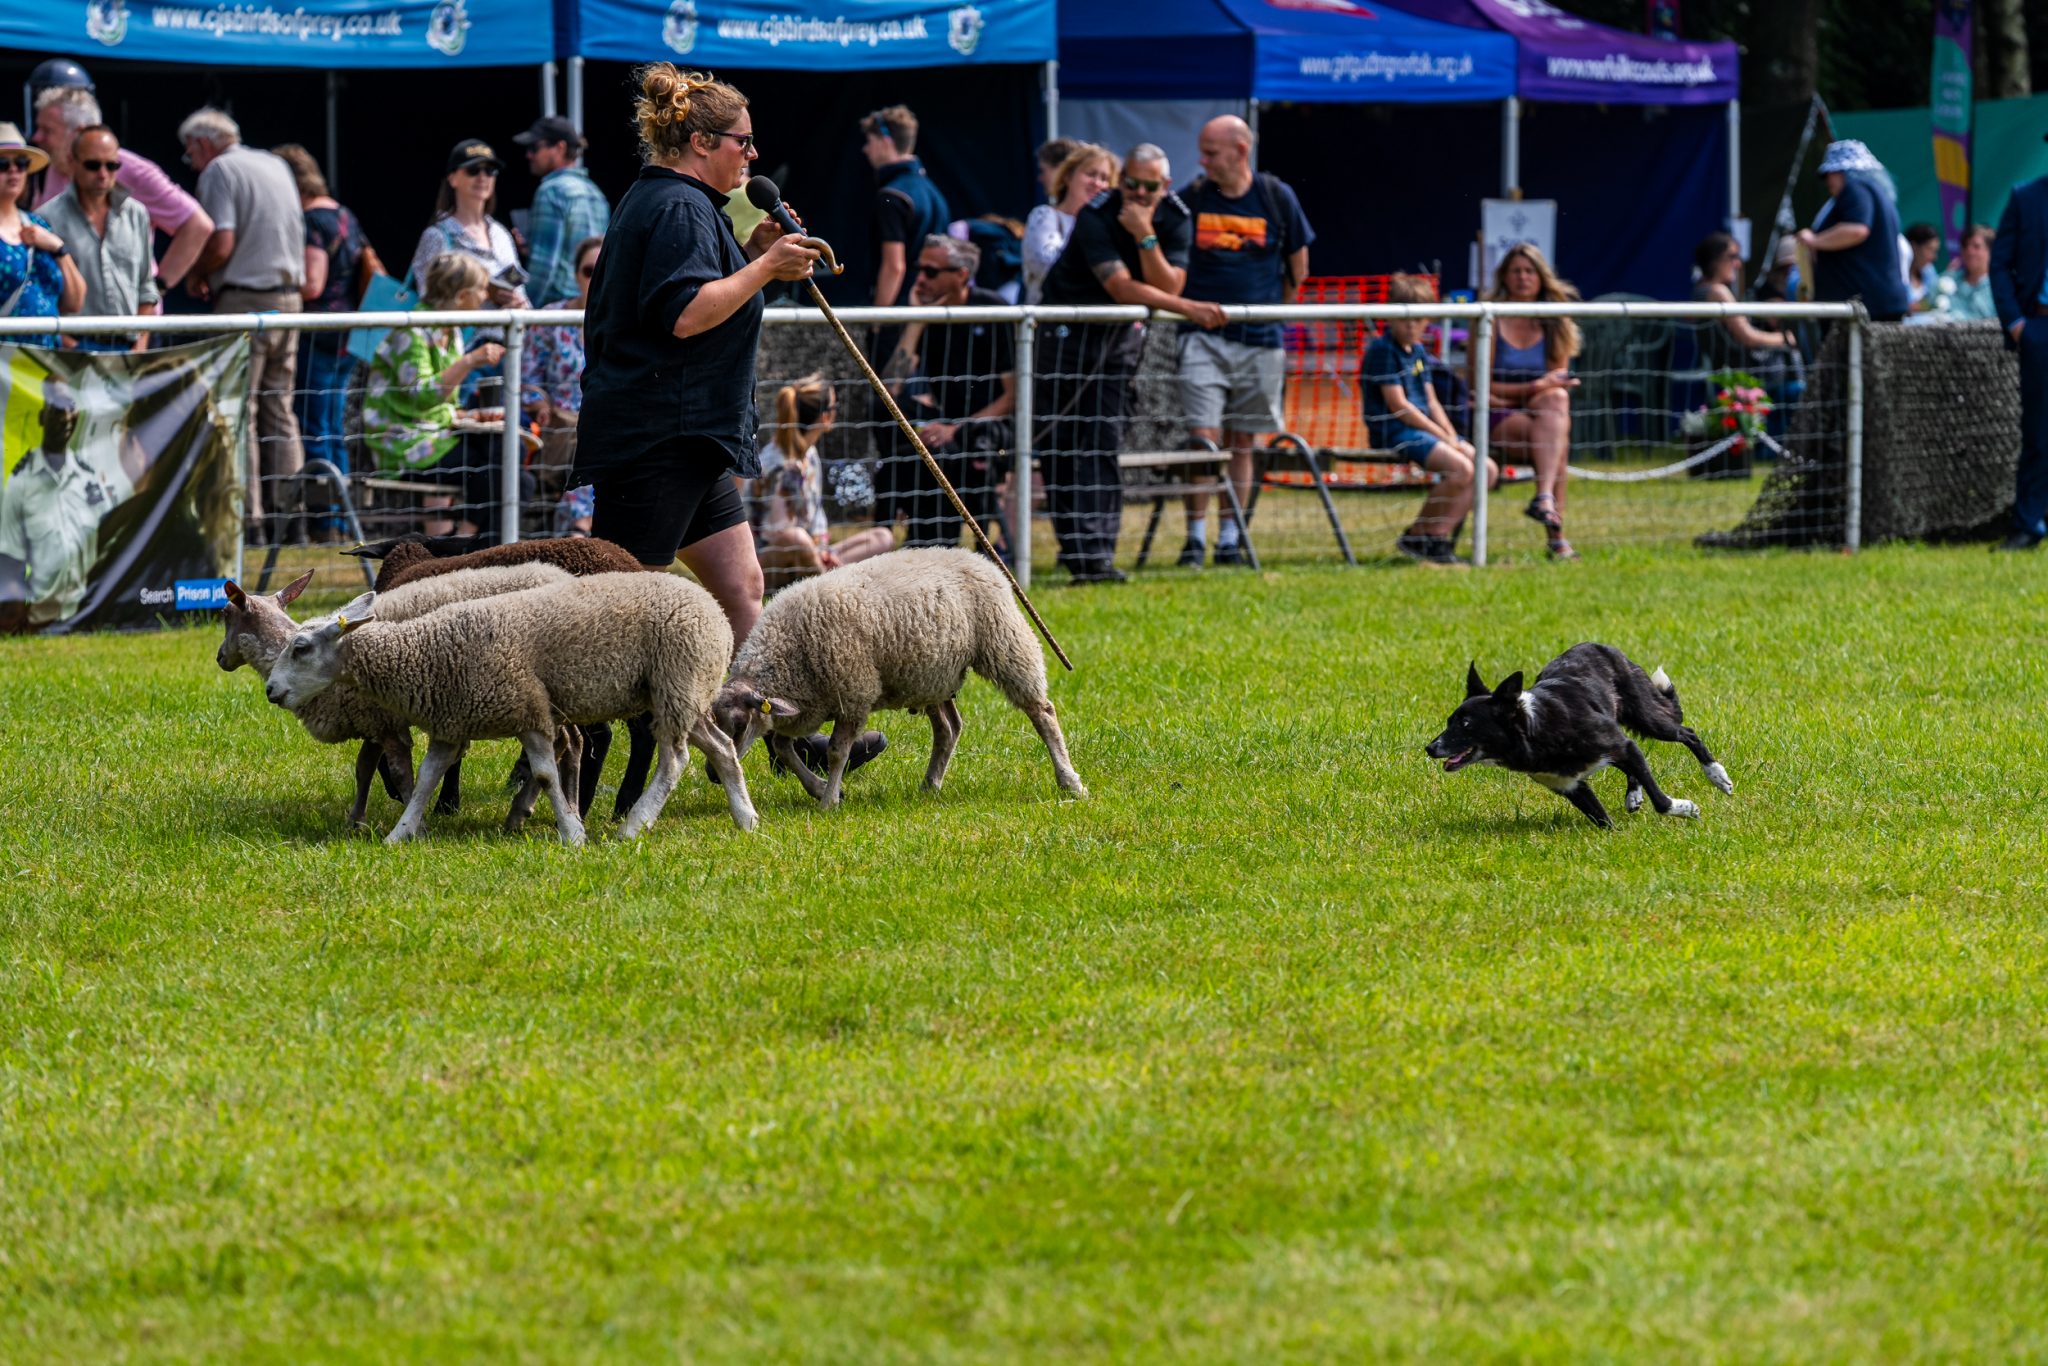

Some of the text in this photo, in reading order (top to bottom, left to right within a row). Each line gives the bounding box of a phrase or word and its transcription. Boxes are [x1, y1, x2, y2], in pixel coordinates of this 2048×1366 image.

[152, 3, 402, 41] www.cjsbirdsofprey.co.uk
[140, 587, 175, 605] Search
[177, 585, 209, 602] Prison
